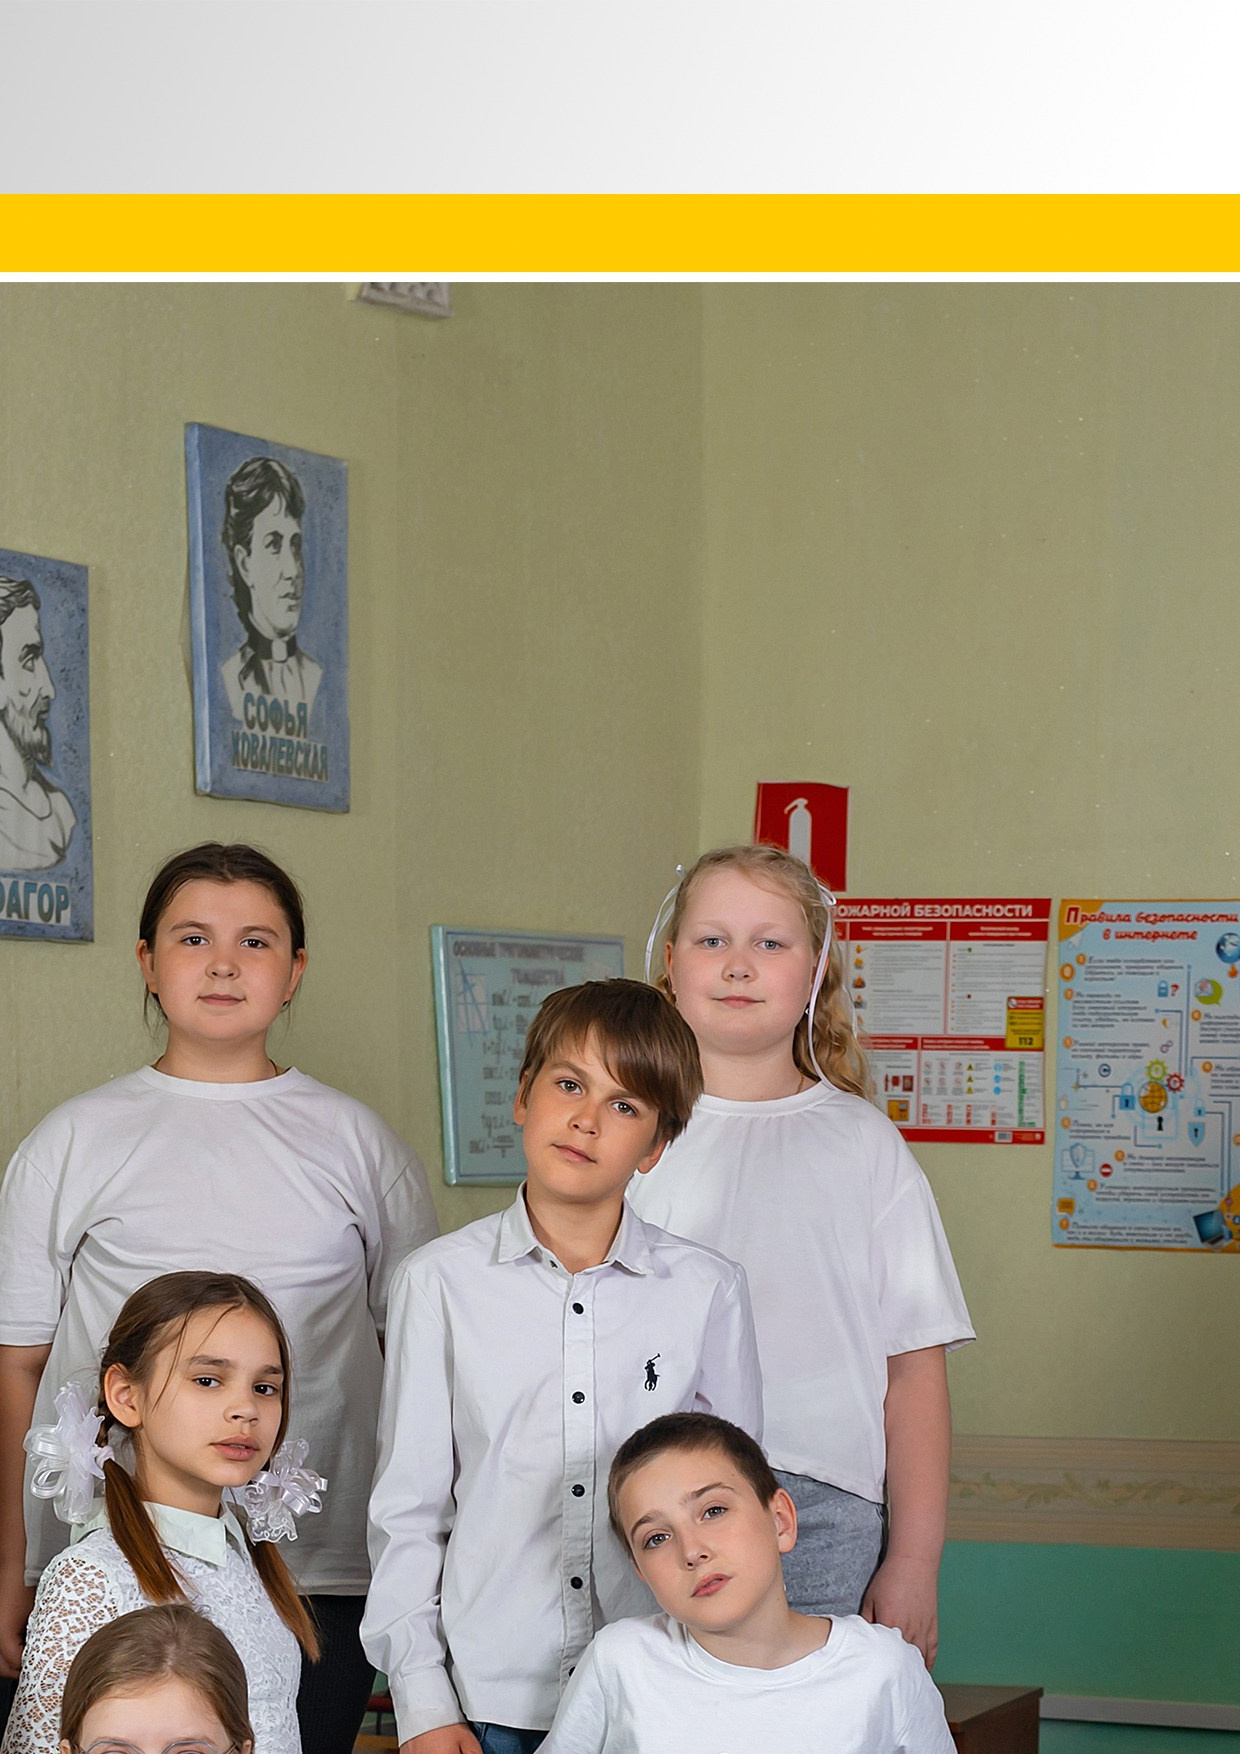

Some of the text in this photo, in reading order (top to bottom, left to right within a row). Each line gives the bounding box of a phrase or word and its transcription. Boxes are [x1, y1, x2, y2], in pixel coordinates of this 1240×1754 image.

[244, 692, 308, 739] СОФЬЯ
[232, 730, 328, 781] КОВАЛЕВСКАЯ
[832, 902, 1033, 917] ОЖАРНОЙ БЕЗОПАСНОСТИ
[1066, 907, 1238, 925] Правила безопасности
[1115, 930, 1198, 942] интернете
